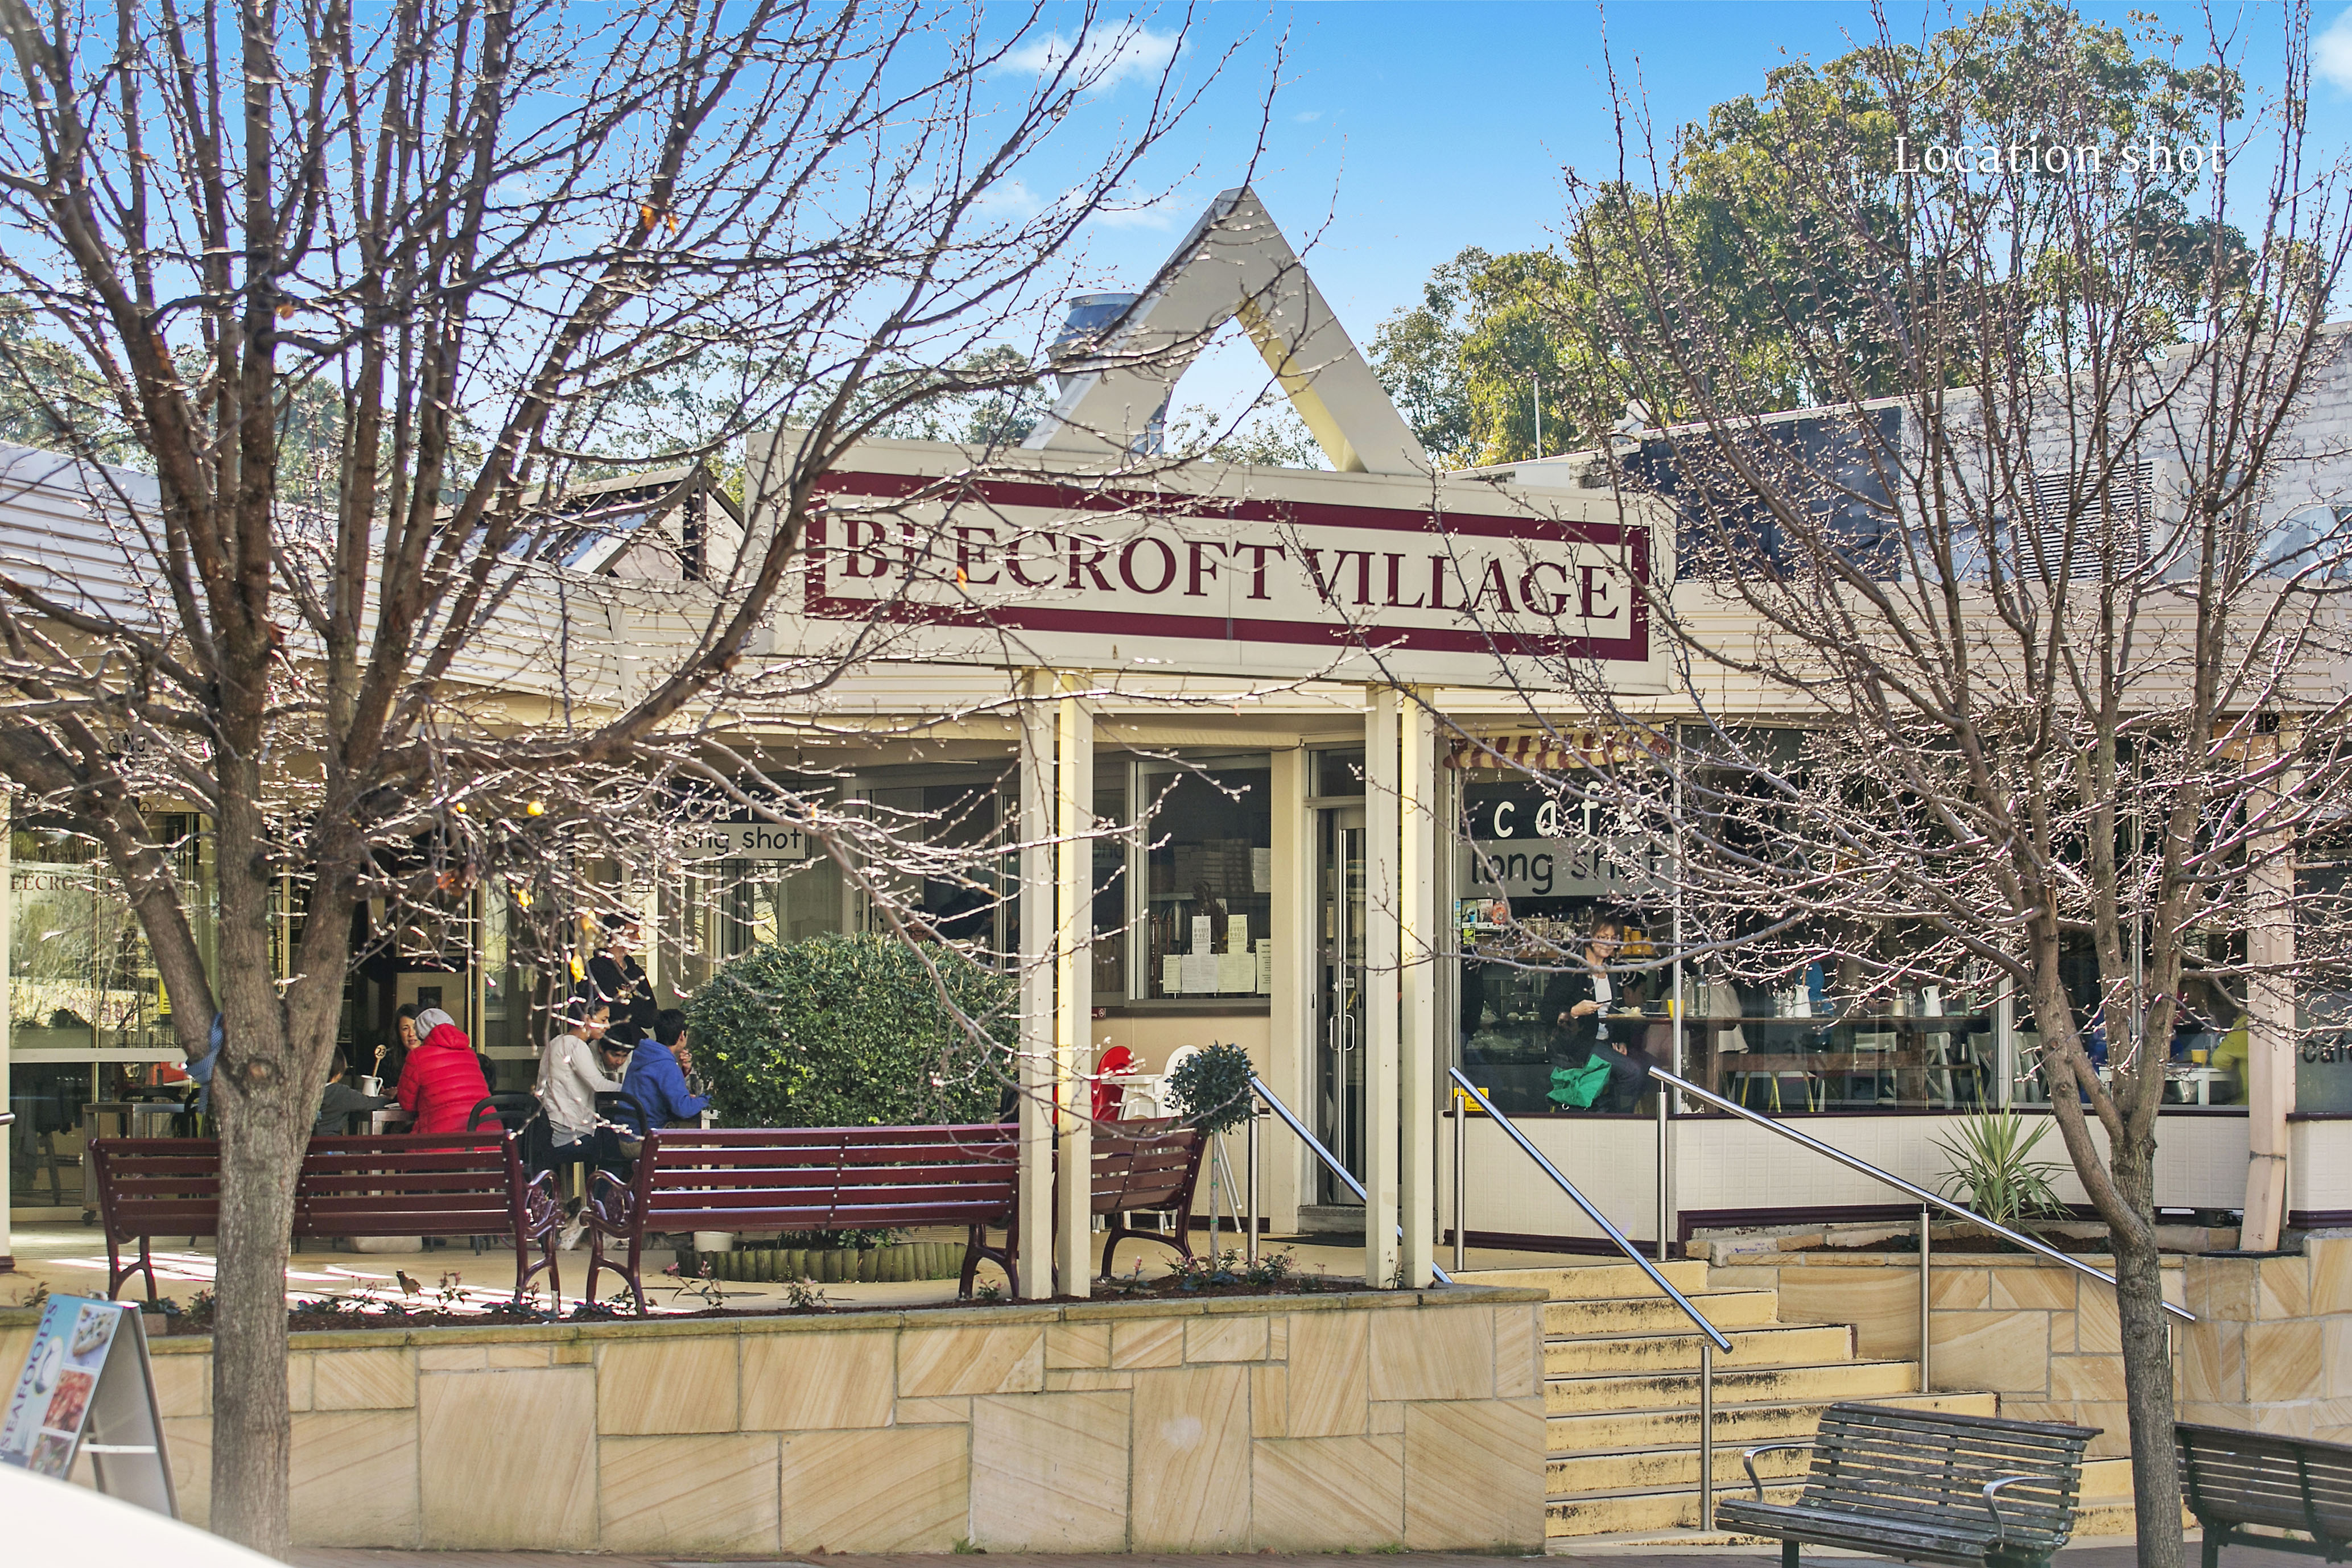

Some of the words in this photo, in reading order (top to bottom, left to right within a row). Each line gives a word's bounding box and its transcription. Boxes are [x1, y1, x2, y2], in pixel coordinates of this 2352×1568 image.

[839, 519, 1286, 600] BEECROFT
[1303, 548, 1620, 620] VILLAGE
[674, 825, 729, 856] ong
[742, 826, 802, 849] shot
[1471, 844, 1553, 896] long
[376, 1047, 386, 1057] 23
[2303, 1031, 2352, 1064] caf
[1, 1303, 57, 1449] SEAFOODS
